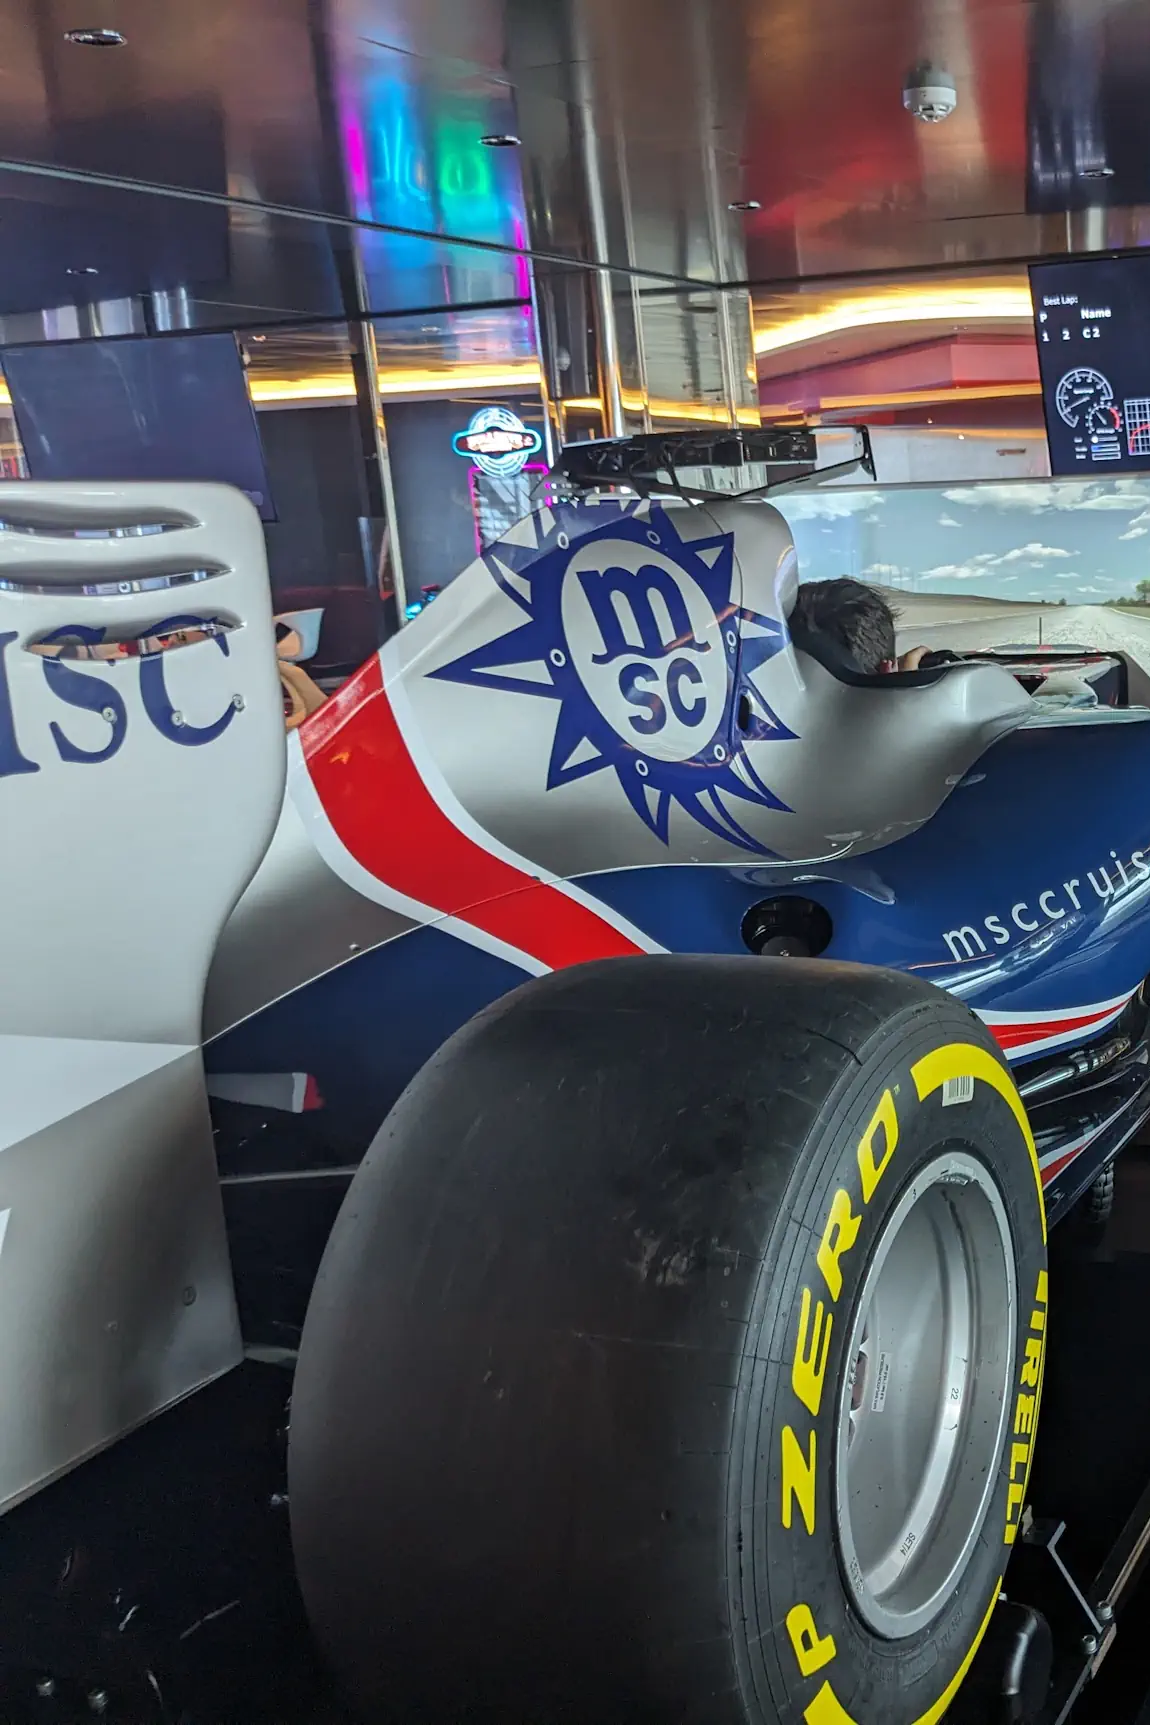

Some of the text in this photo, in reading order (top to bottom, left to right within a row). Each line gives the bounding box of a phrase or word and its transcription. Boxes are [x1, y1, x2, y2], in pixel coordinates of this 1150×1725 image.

[1043, 295, 1078, 306] Best Lap:
[1039, 312, 1048, 323] P
[1080, 308, 1112, 320] Name
[1042, 330, 1050, 342] 1
[1062, 328, 1071, 340] 2
[781, 1089, 899, 1536] ZERO
[950, 1387, 959, 1400] 22
